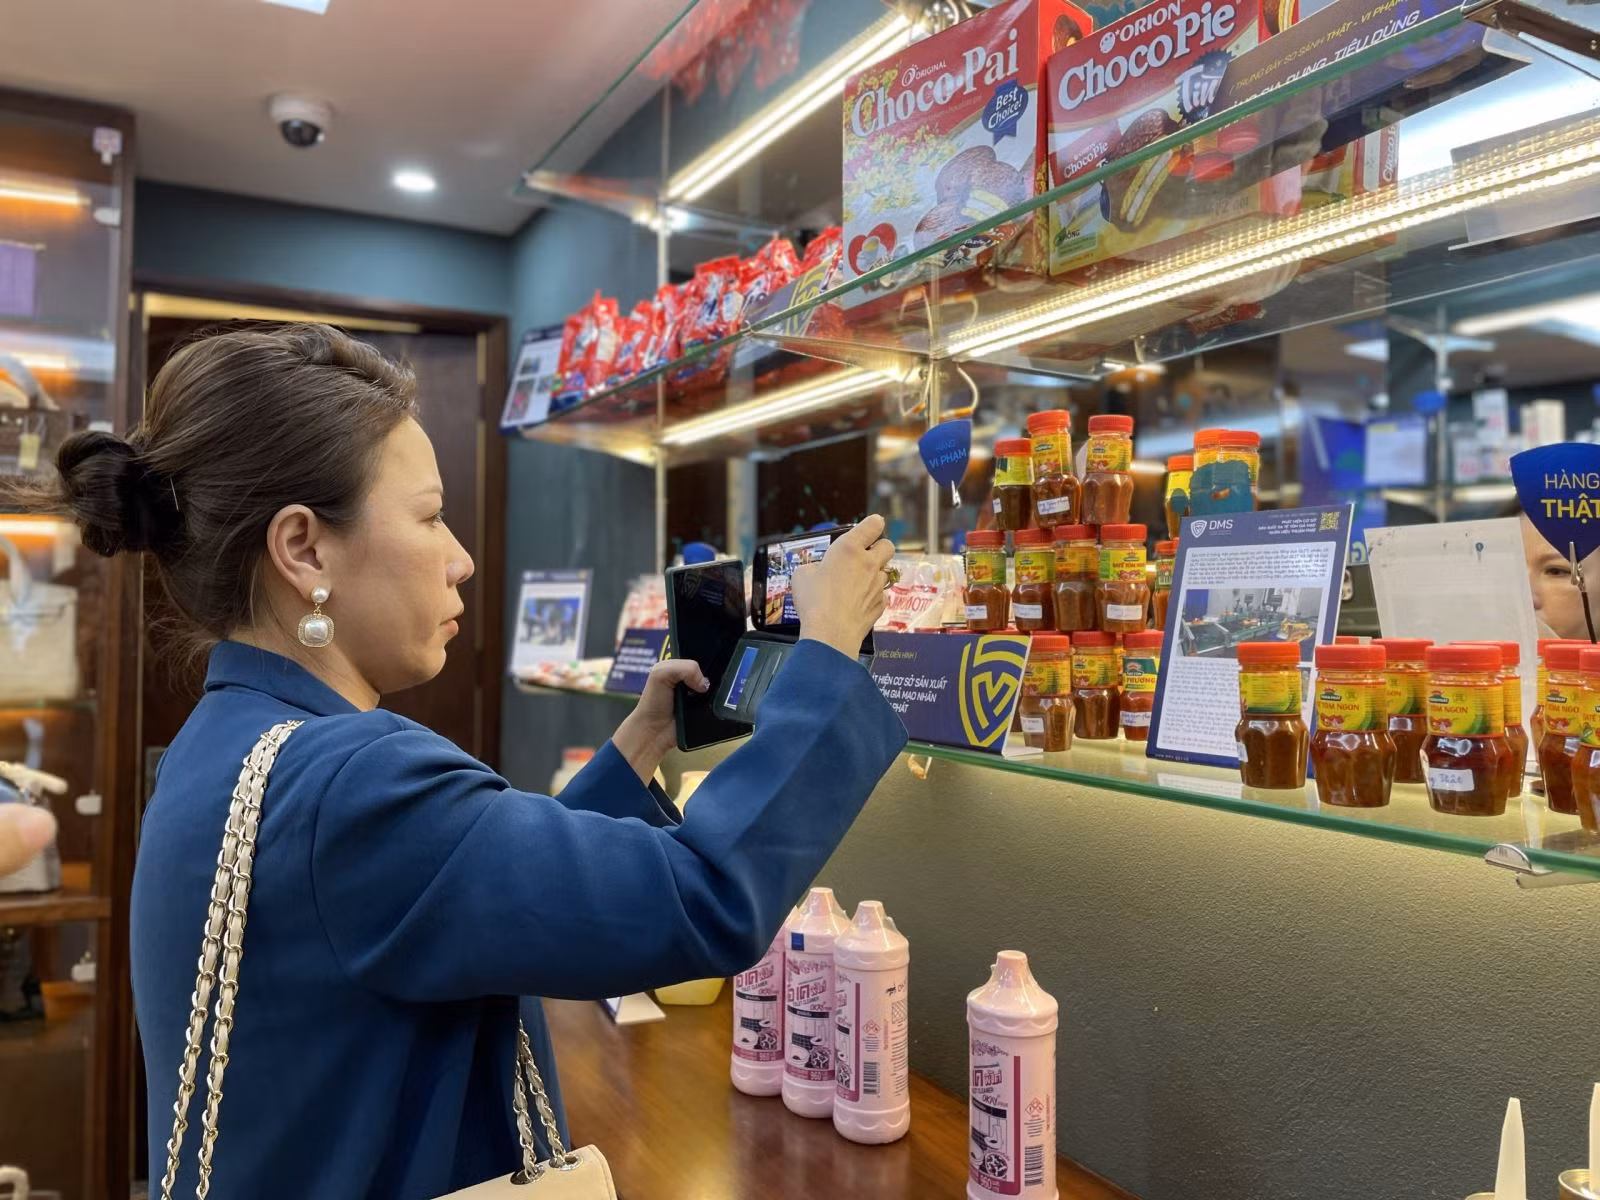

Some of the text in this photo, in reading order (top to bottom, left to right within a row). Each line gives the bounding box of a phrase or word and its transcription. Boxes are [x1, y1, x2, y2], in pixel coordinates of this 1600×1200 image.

[1120, 0, 1181, 41] ORION
[1326, 21, 1351, 41] THẬT
[1361, 12, 1371, 23] VI
[1058, 2, 1235, 110] ChocoPie
[915, 60, 947, 80] ORIGINAL
[996, 87, 1019, 110] Best
[988, 94, 1023, 129] Choice!
[1063, 141, 1109, 178] ChocoPie
[929, 447, 967, 468] VI PHẠM
[1545, 468, 1600, 489] HÀNG
[1540, 493, 1600, 524] THẬT
[1209, 519, 1234, 530] DMS
[914, 675, 929, 688] SẢN
[928, 676, 948, 690] XUẤT
[1336, 703, 1360, 711] NGON
[1444, 706, 1468, 714] NGON
